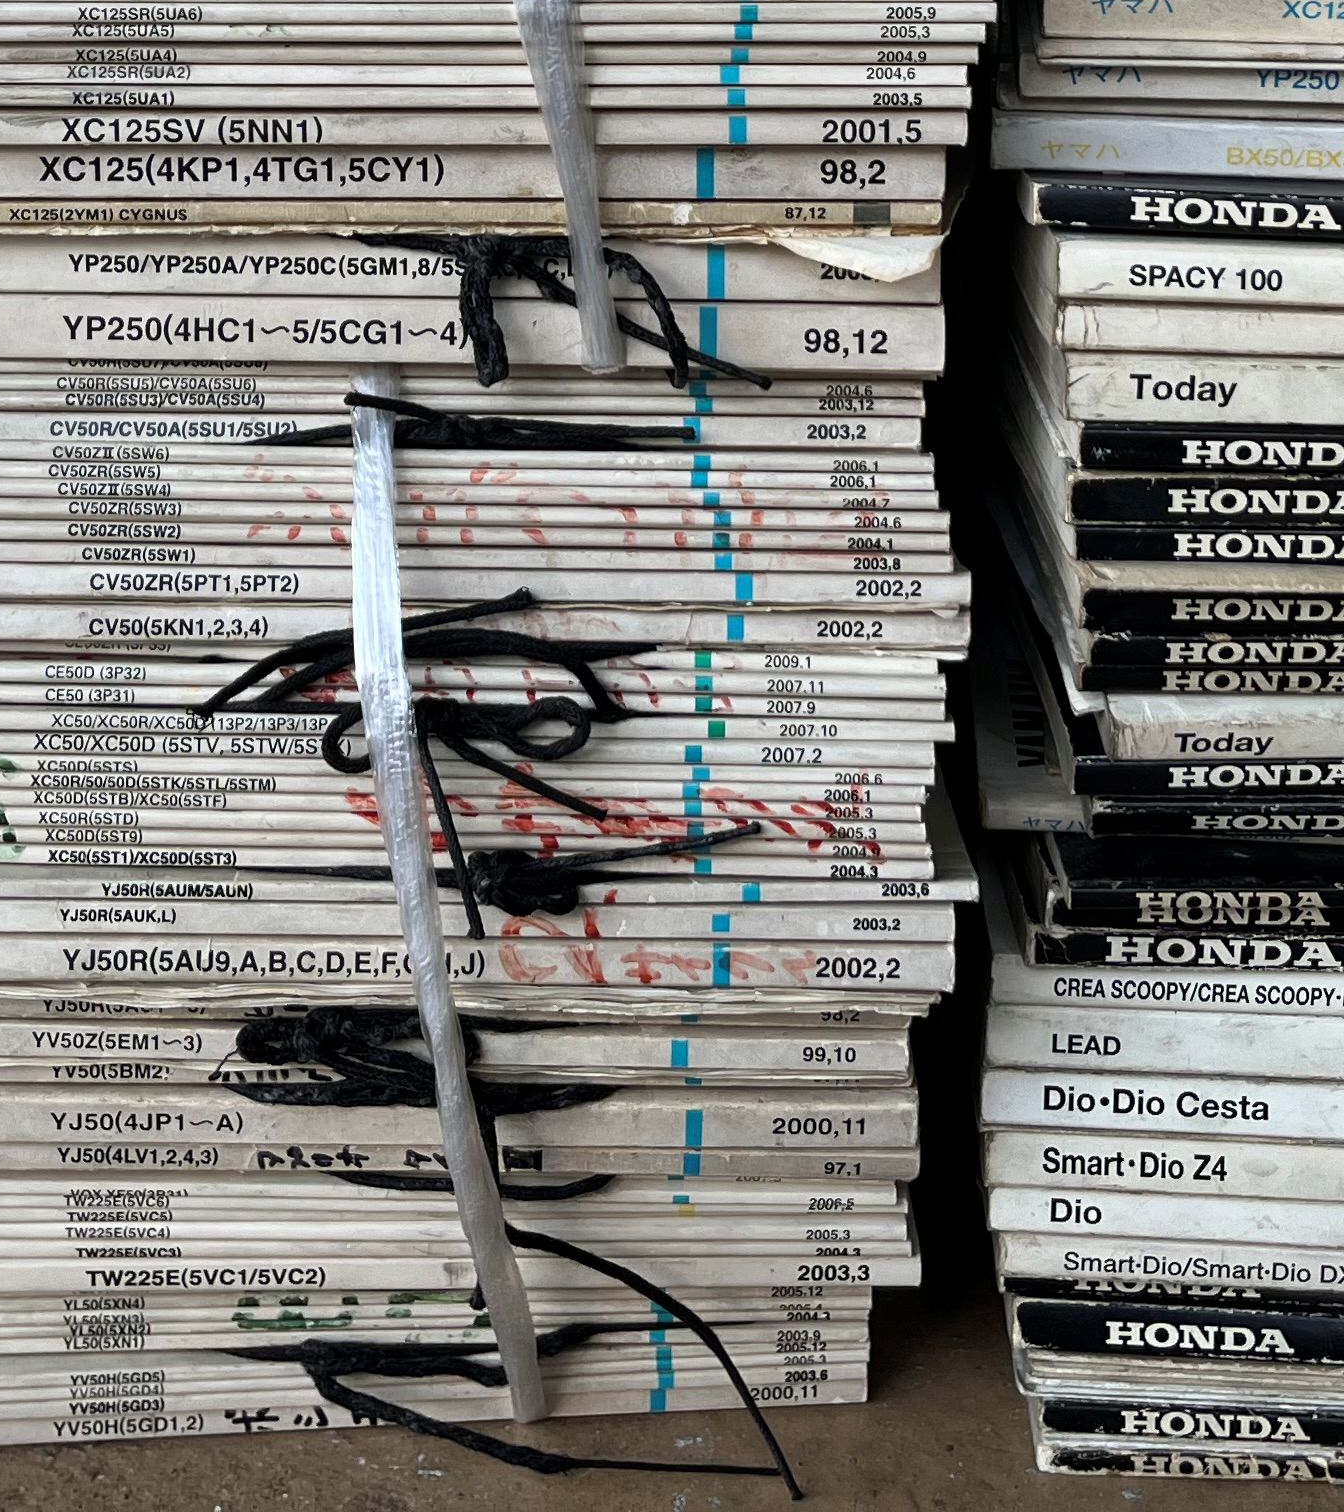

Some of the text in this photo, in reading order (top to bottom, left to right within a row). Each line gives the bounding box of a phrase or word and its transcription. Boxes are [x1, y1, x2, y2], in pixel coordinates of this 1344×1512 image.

[1256, 69, 1341, 91] YP250
[62, 116, 323, 145] XC125SV (5NN1)
[118, 208, 187, 220] CYGNUS
[1130, 196, 1341, 230] HONDA
[1129, 264, 1283, 291] SPACY 100
[1130, 373, 1237, 407] Today
[44, 665, 95, 679] CE50D
[764, 655, 812, 669] 2009.1
[45, 688, 84, 702] CE50
[779, 724, 838, 738] 2007.10
[761, 747, 823, 764] 2007.2
[1174, 733, 1273, 757] Today
[1104, 936, 1342, 967] HONDA
[1054, 977, 1250, 1004] CREA SCOOPY/CREA
[1051, 1033, 1121, 1055] LEAD
[1176, 1091, 1270, 1121] Cesta
[1193, 1154, 1228, 1182] Z4
[1050, 1198, 1102, 1224] Dio
[1104, 1321, 1294, 1353] HONDA
[1120, 1411, 1310, 1442] HONDA
